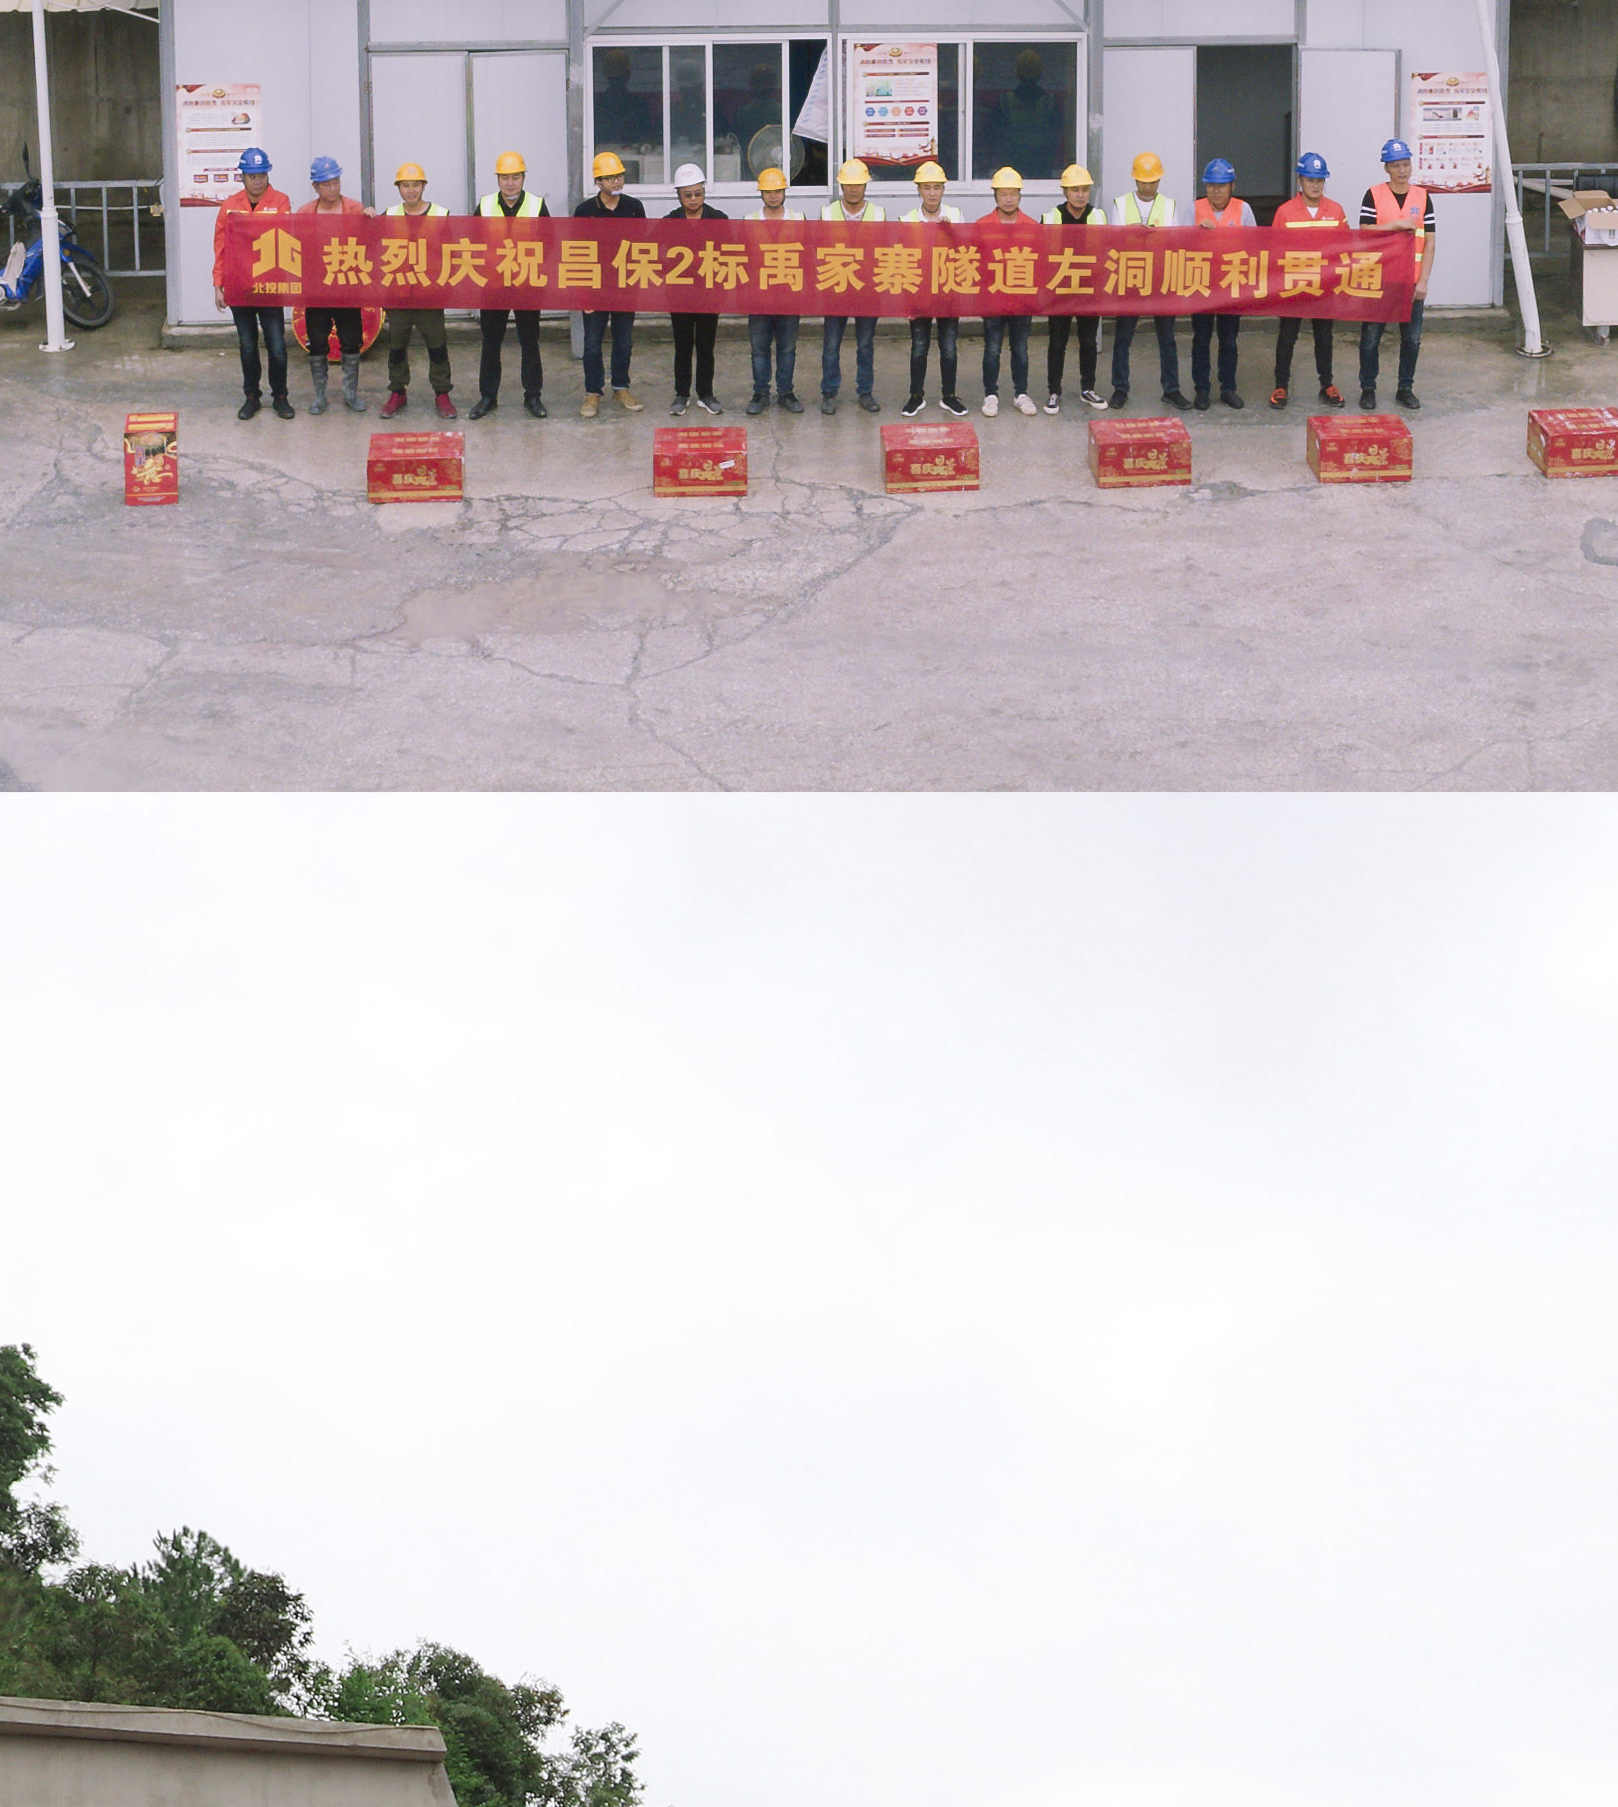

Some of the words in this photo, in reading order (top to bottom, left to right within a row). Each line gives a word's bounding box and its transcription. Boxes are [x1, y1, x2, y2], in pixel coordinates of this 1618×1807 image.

[323, 237, 1384, 300] 热烈庆祝昌保2标禹家寨隧道左洞顺利贯通
